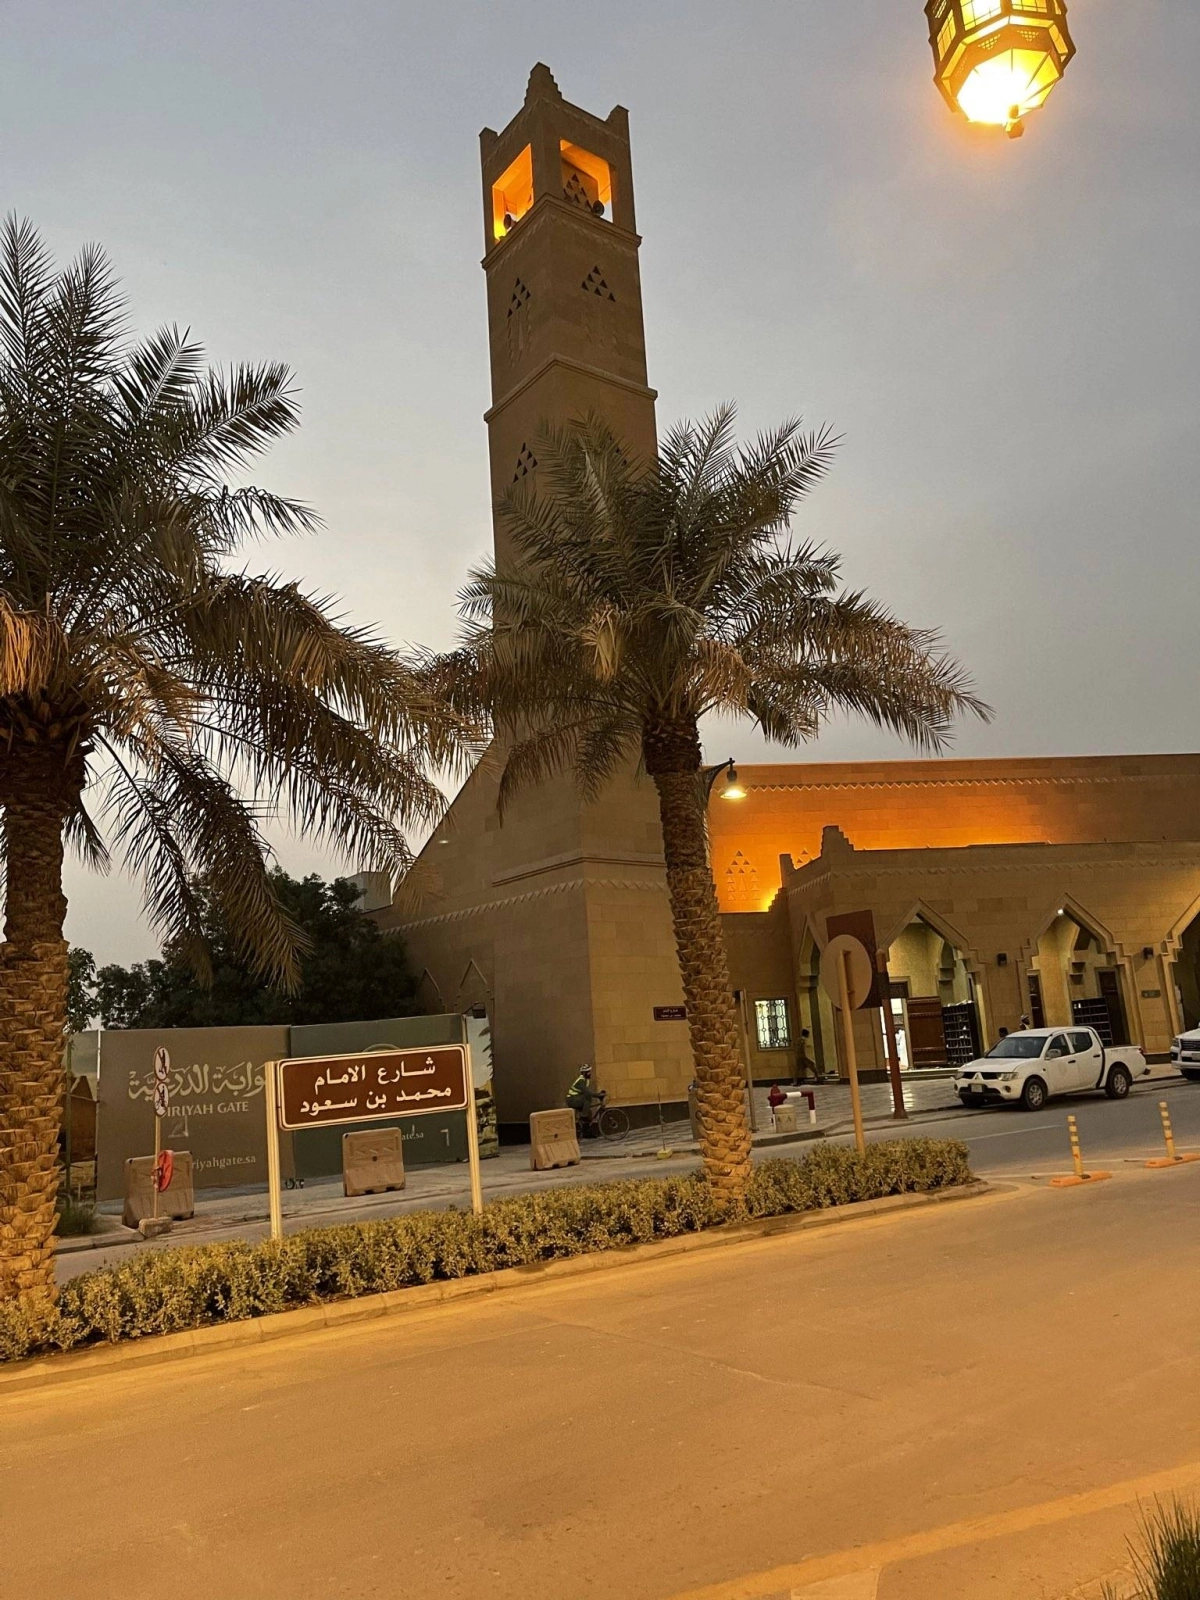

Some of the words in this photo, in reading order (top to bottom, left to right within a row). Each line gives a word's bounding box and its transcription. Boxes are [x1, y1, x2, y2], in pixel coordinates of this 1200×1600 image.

[212, 1062, 266, 1098] وابة
[314, 1064, 366, 1095] الامام
[377, 1056, 436, 1085] شارع
[366, 1090, 387, 1109] بن
[396, 1086, 452, 1102] محمد
[162, 1103, 213, 1119] IRIYAH
[217, 1101, 250, 1114] GATE
[300, 1097, 358, 1116] سعود
[191, 1155, 256, 1172] riyahgate.sa
